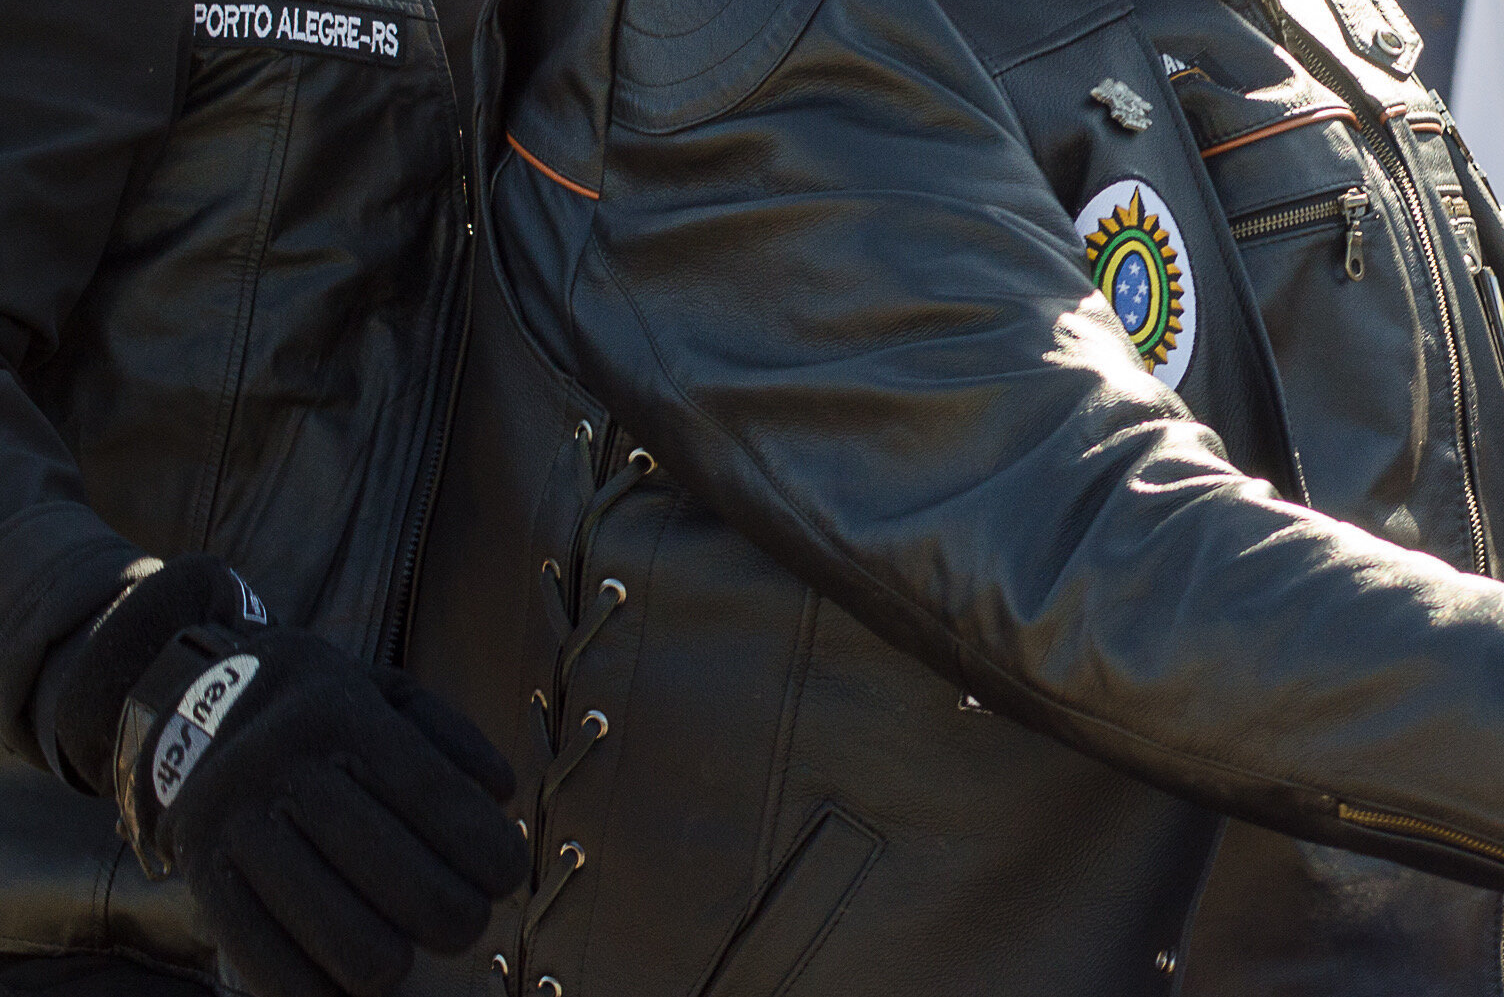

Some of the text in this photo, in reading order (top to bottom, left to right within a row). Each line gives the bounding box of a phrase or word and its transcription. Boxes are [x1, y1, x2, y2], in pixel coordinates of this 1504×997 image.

[193, 3, 399, 57] PORTO ALEGRE-RS
[158, 666, 241, 788] reusch
